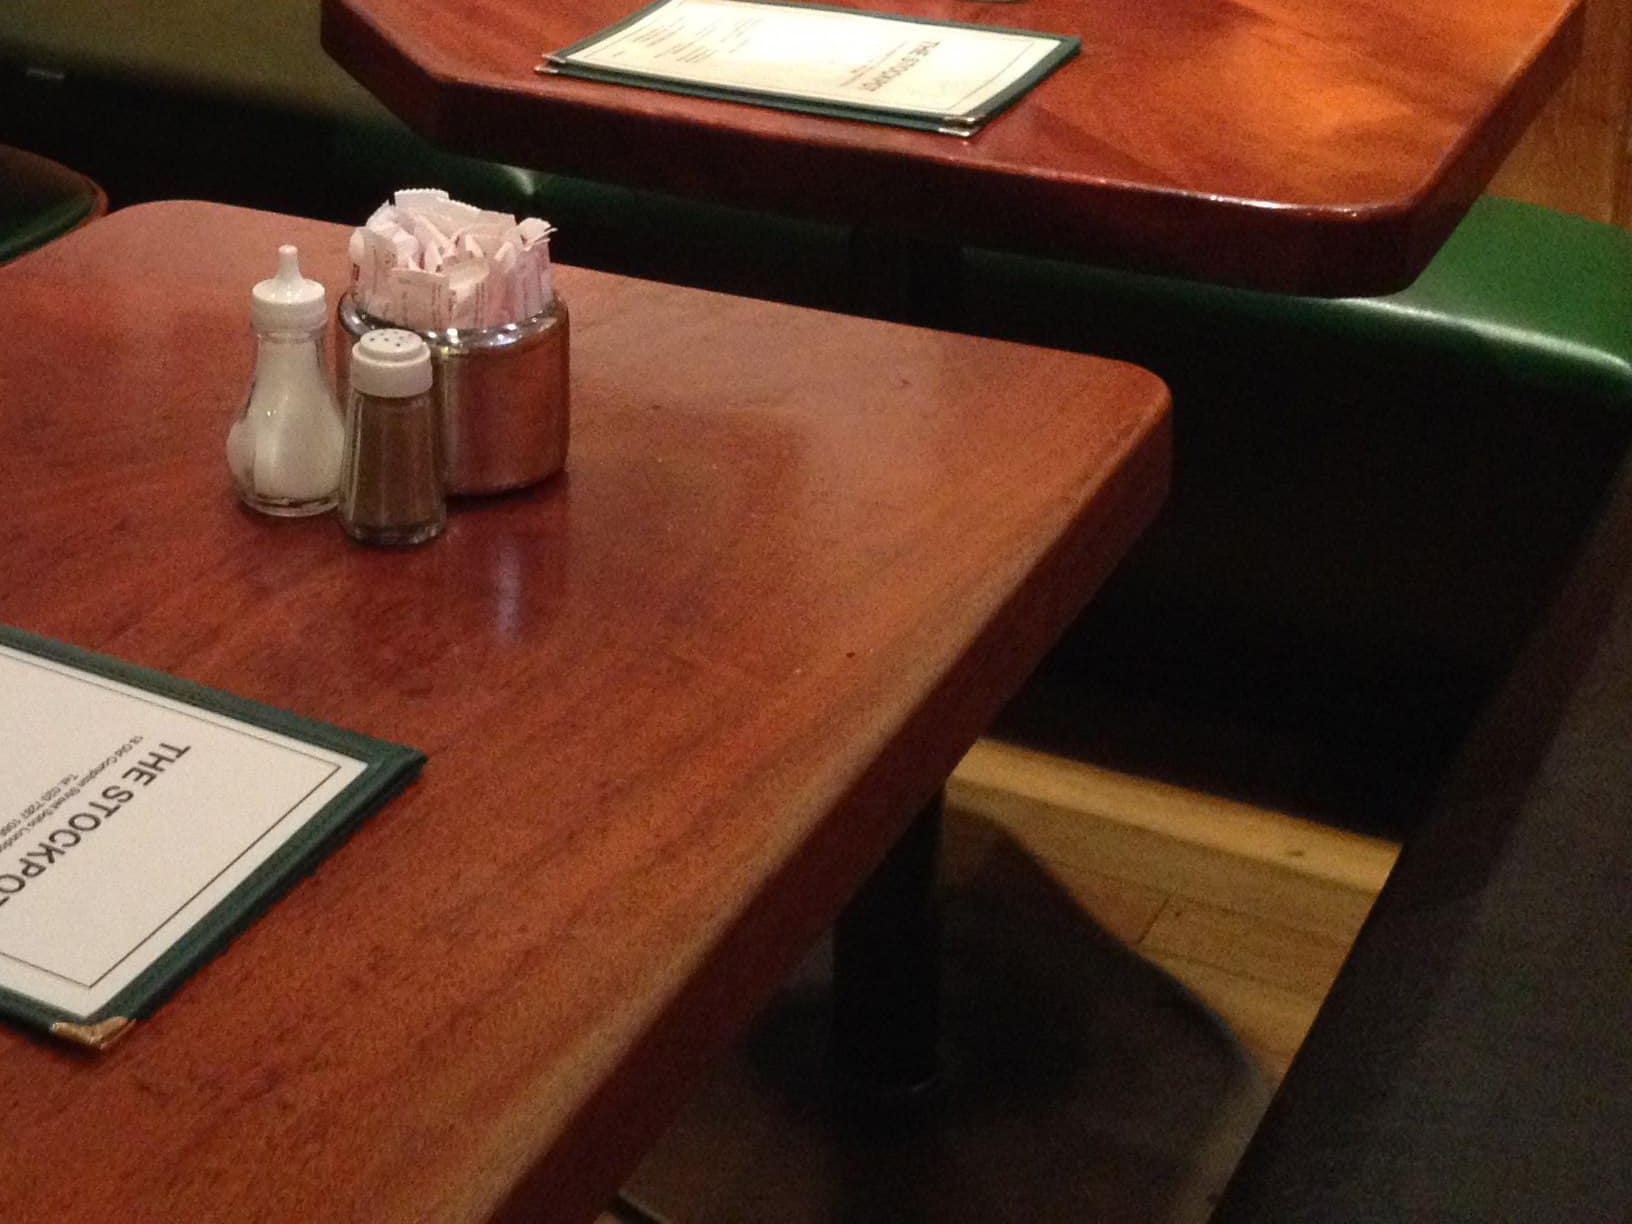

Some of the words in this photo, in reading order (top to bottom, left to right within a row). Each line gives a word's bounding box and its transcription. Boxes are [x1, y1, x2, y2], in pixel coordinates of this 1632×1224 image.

[908, 42, 941, 57] THE
[77, 756, 119, 788] Compton
[122, 743, 192, 787] THE
[50, 787, 81, 810] Street
